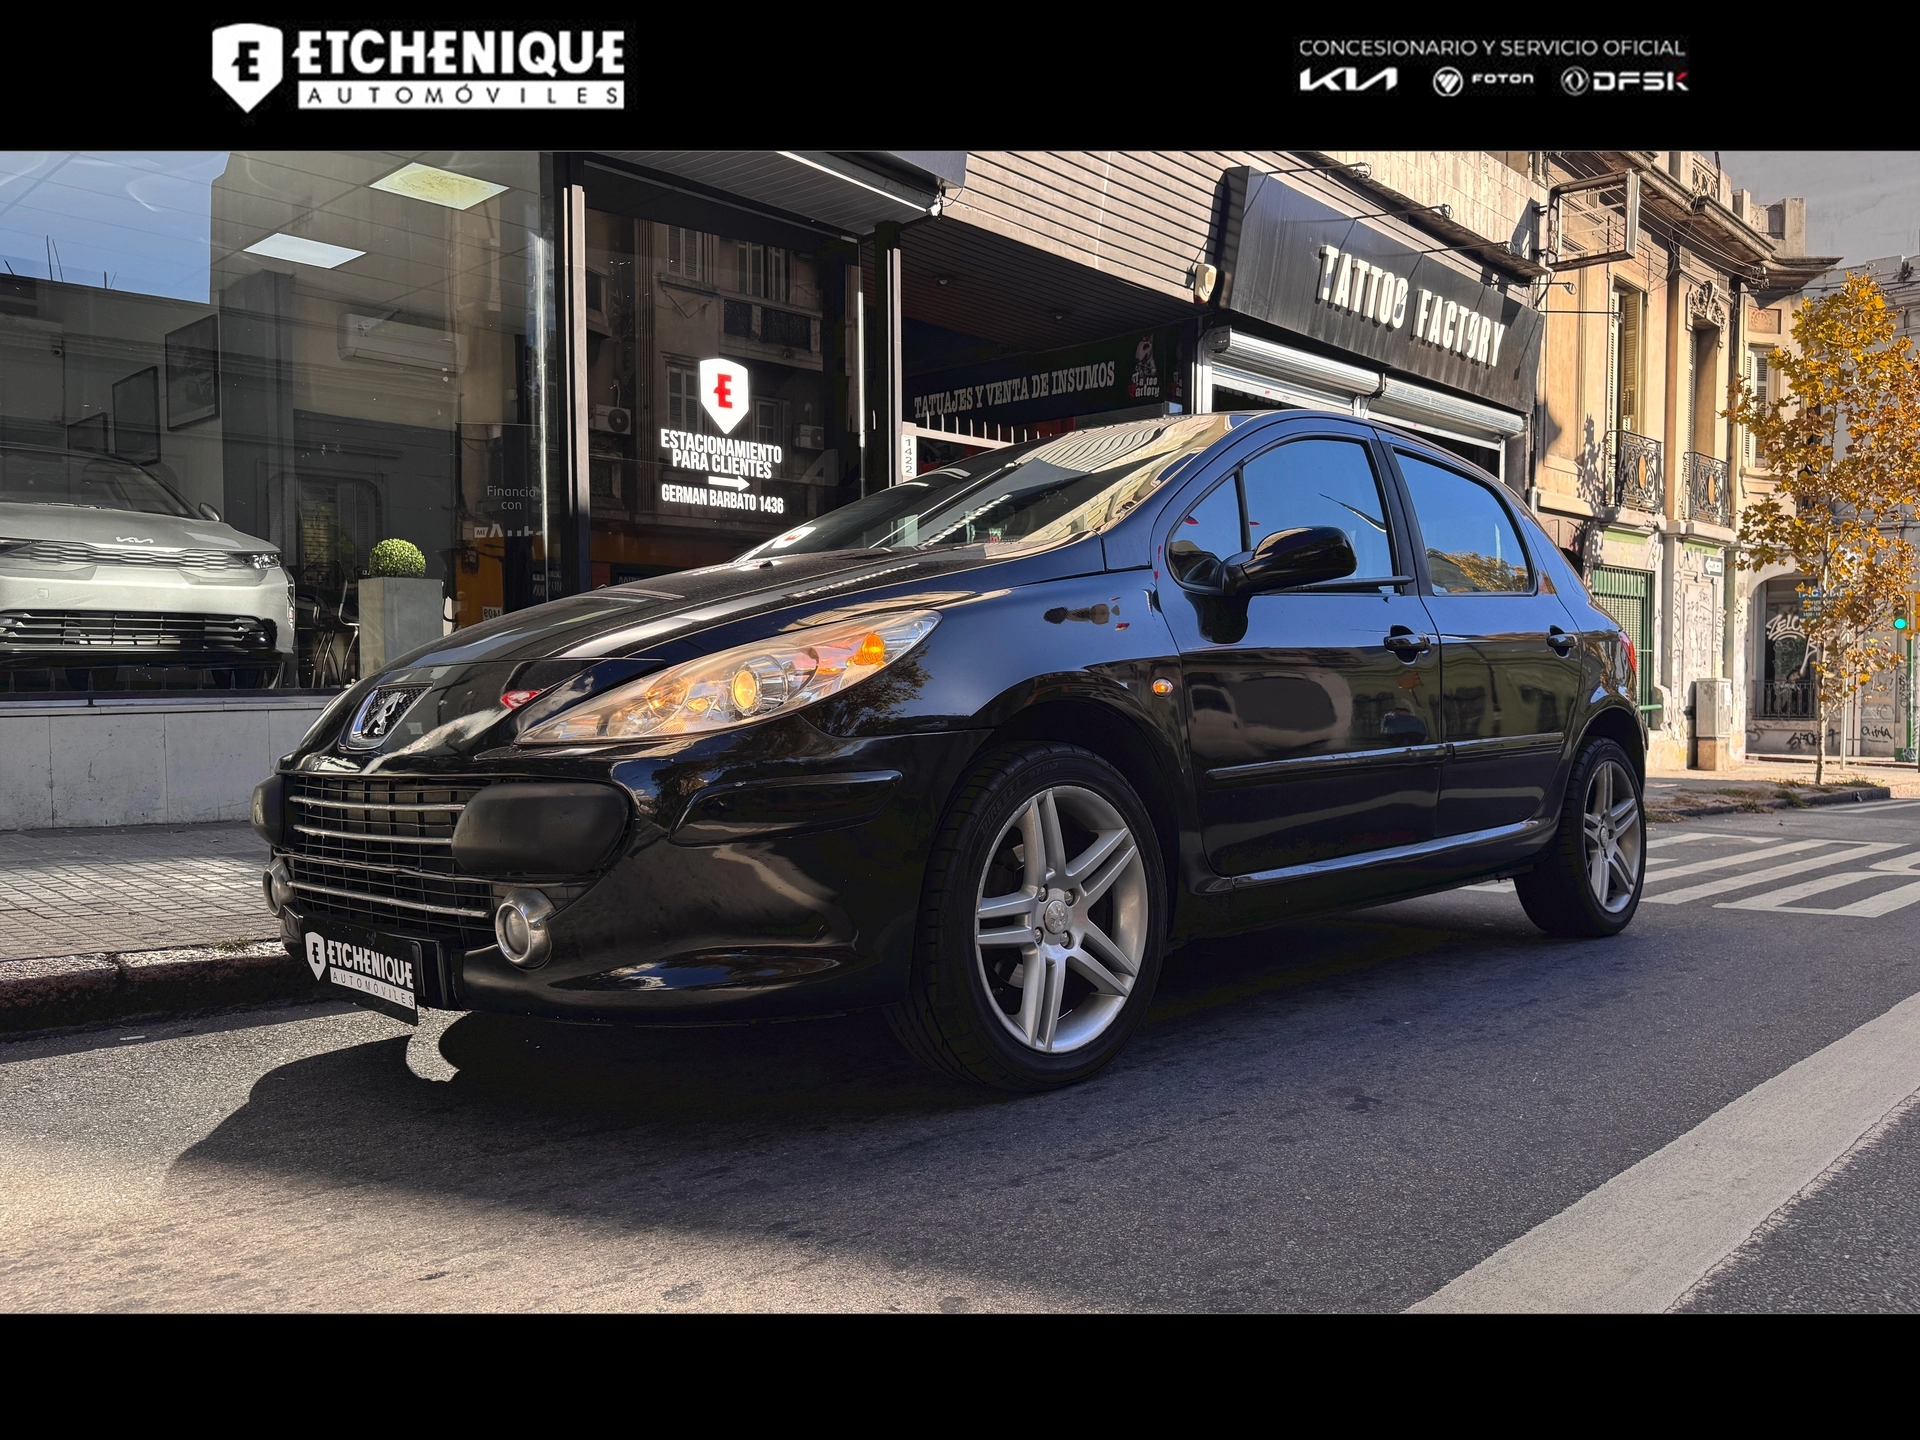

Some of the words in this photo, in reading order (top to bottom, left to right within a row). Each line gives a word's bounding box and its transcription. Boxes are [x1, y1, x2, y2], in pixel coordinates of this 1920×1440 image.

[1317, 244, 1409, 329] TATTOO
[1412, 289, 1506, 368] FACTORY
[914, 386, 973, 419] TATUAJES
[975, 385, 984, 408] Y
[986, 376, 1030, 406] VENTA
[1032, 372, 1049, 399] DE
[1051, 360, 1115, 395] INSUMOS
[660, 428, 783, 464] ESTACIONAMIENTO
[672, 449, 709, 472] PARA
[711, 454, 773, 479] CLIENTES
[904, 438, 913, 474] 1422
[487, 485, 536, 498] Financia
[501, 501, 522, 510] con
[661, 484, 708, 506] GERMAN
[709, 489, 757, 511] BARBATO
[759, 496, 784, 514] 1436
[327, 940, 414, 989] ETCHENIQUE
[332, 971, 414, 1007] AUTOMÓVILES
